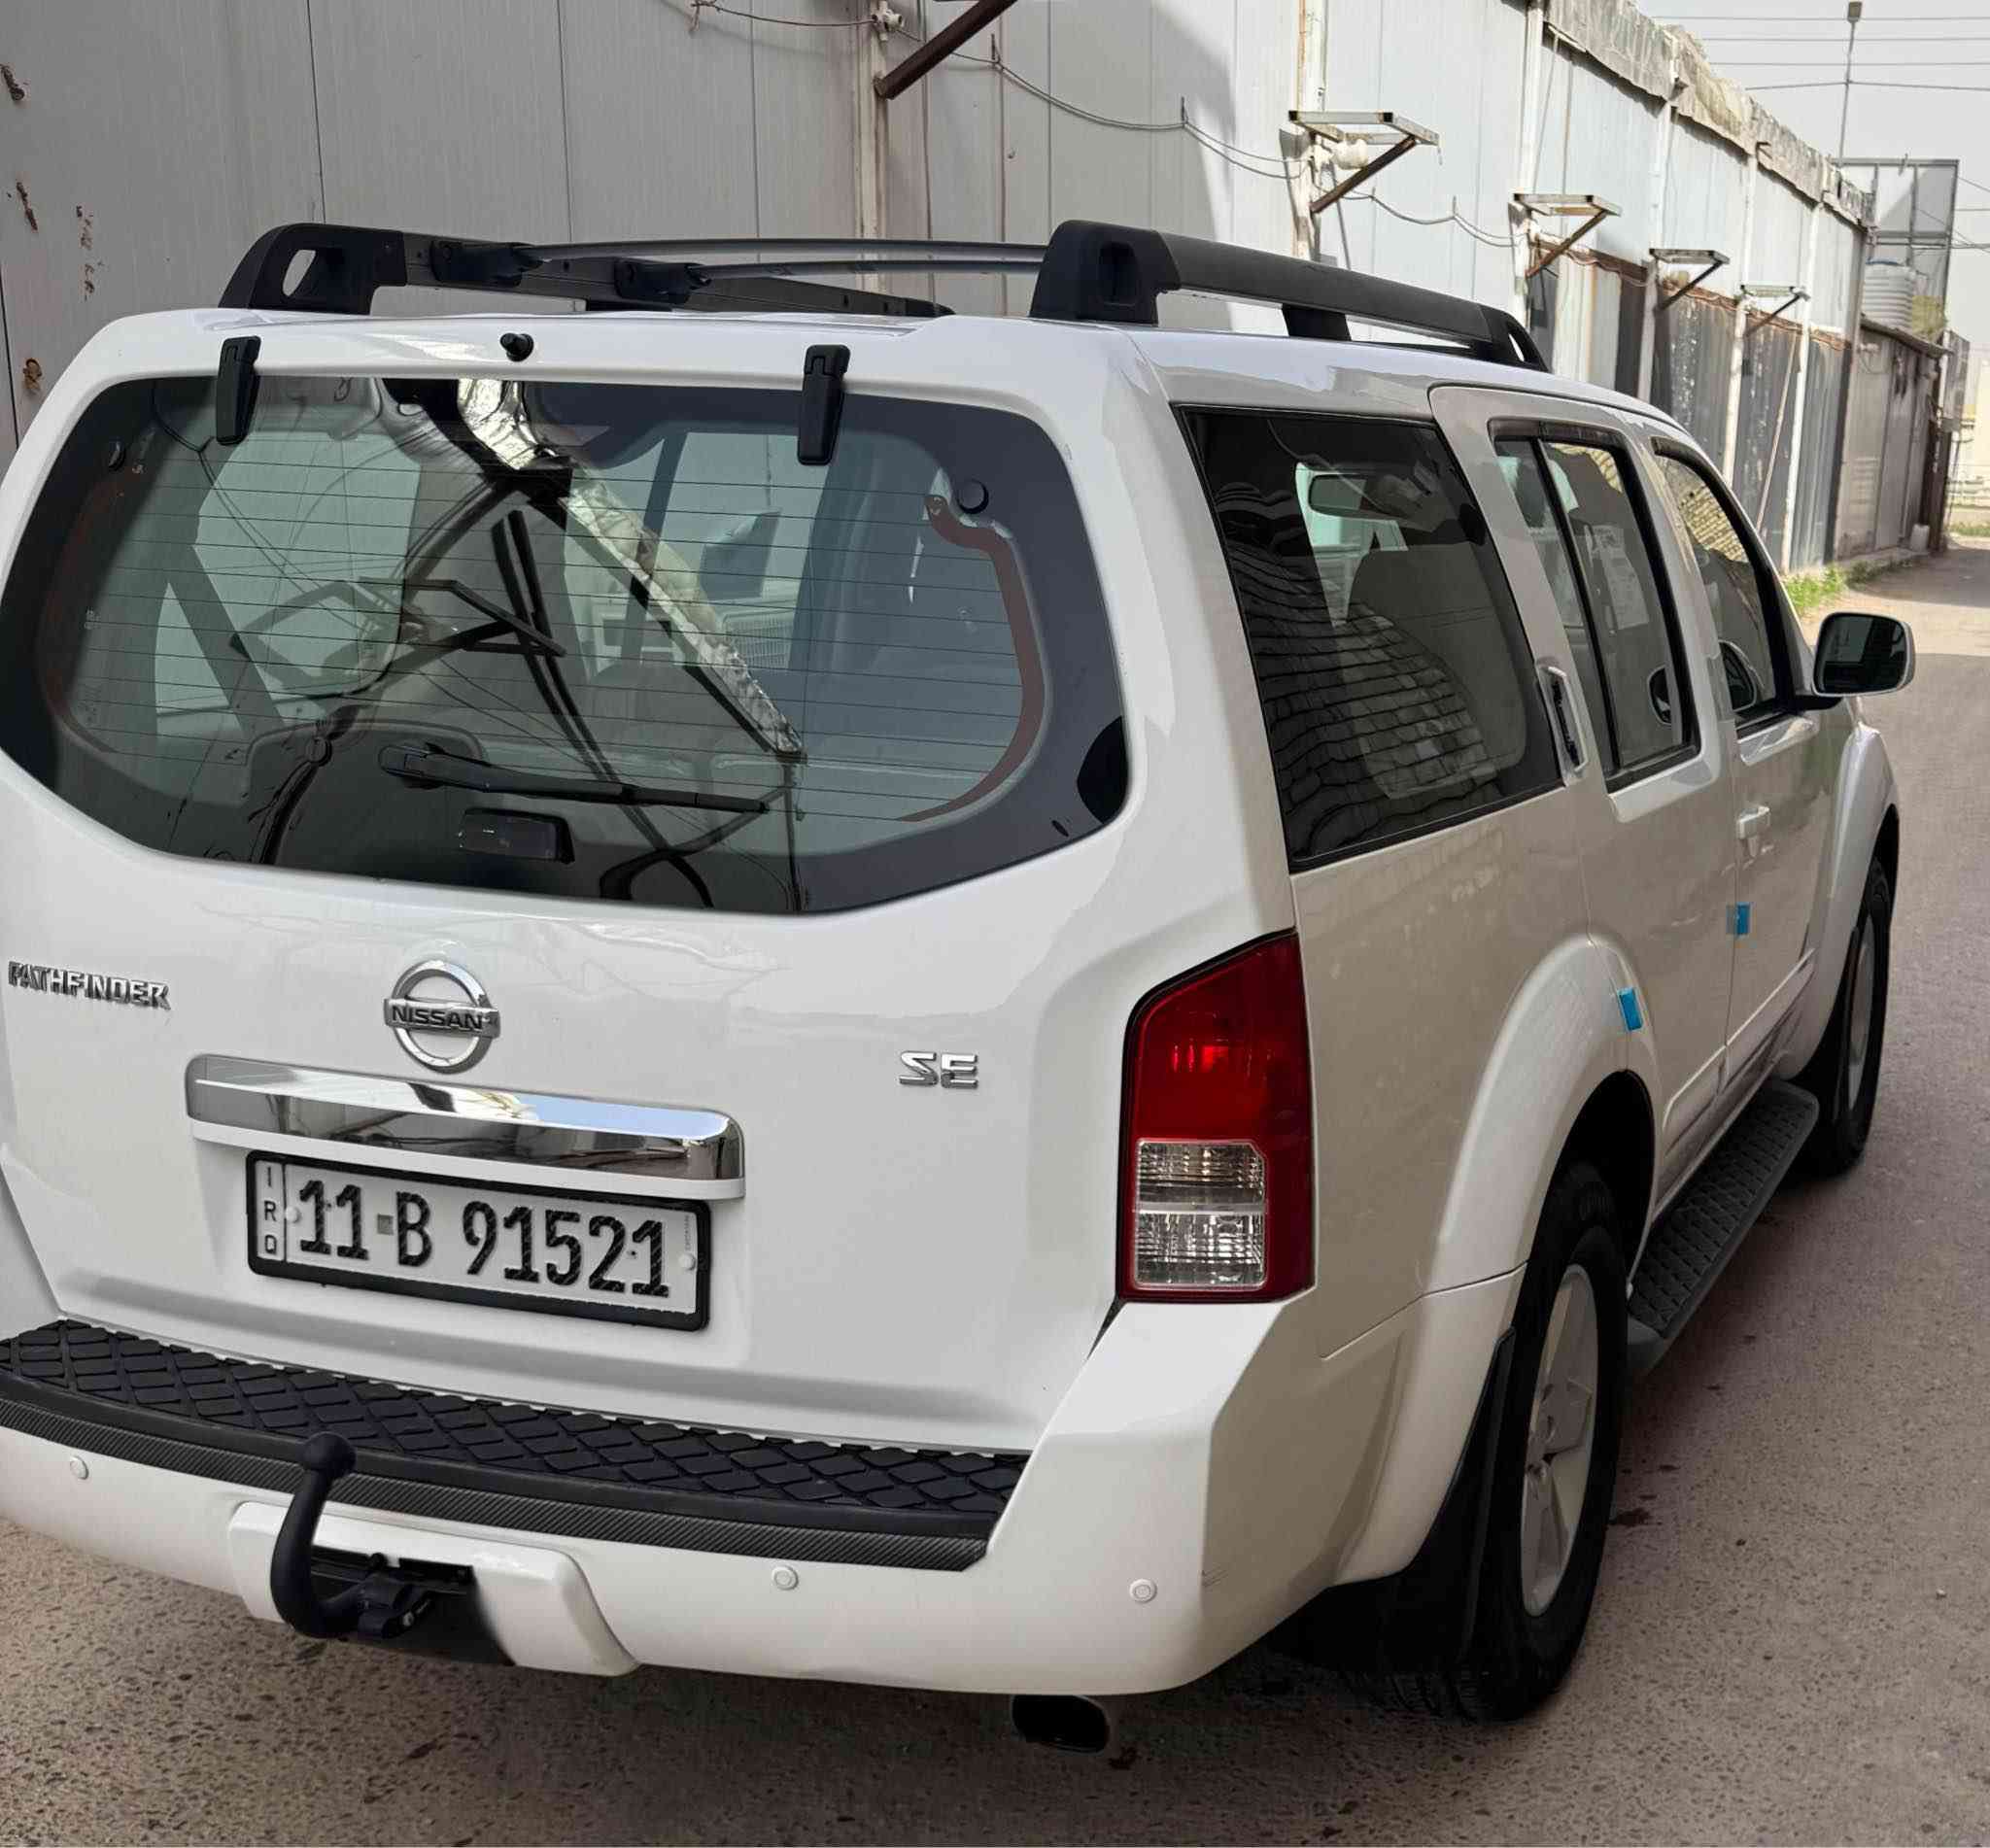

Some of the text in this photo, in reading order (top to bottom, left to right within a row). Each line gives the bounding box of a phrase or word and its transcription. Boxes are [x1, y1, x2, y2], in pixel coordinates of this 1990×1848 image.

[8, 961, 171, 1010] PATHFINDER
[392, 1005, 483, 1030] NISSAN
[899, 1050, 978, 1089] SE
[299, 1180, 369, 1261] 11
[396, 1191, 432, 1267] B
[463, 1200, 669, 1298] 91521
